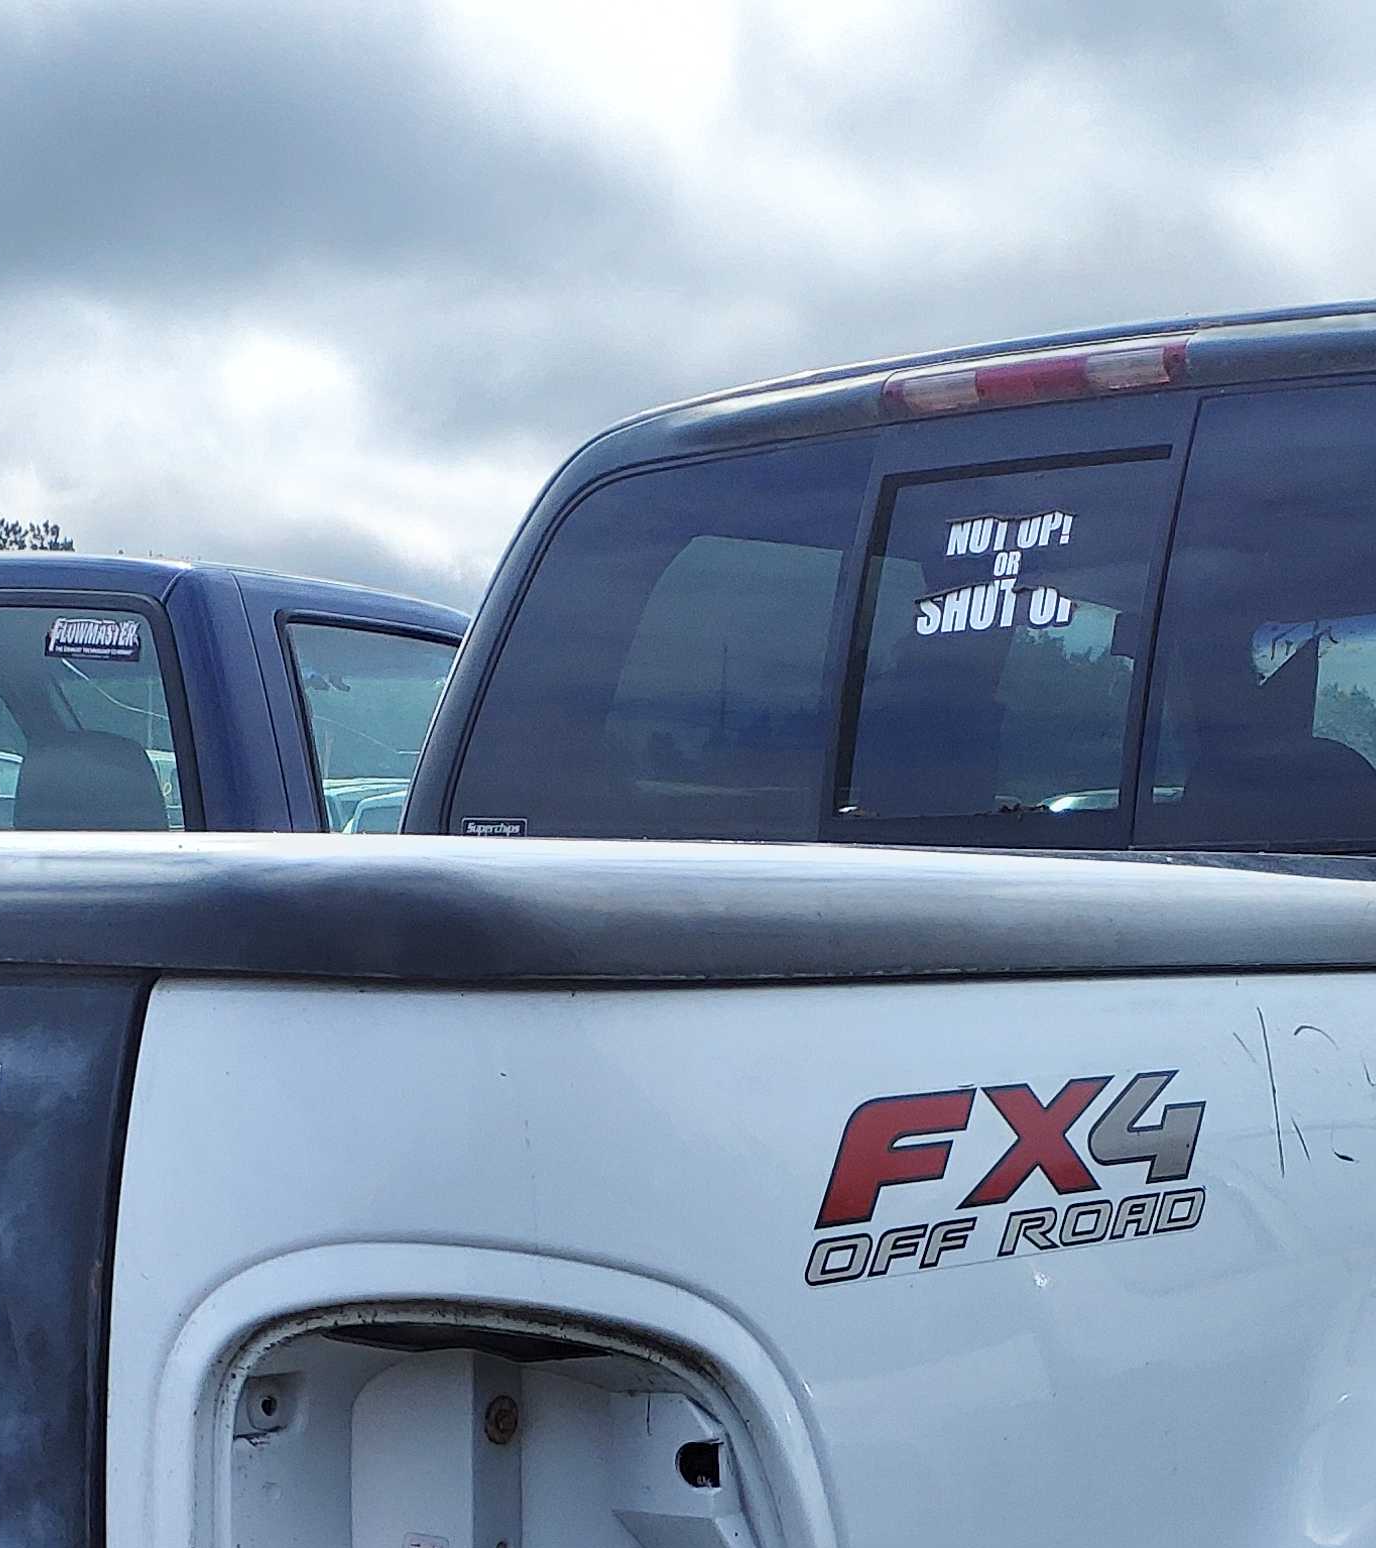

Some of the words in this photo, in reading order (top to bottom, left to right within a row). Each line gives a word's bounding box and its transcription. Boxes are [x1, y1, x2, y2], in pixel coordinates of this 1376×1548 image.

[1016, 510, 1074, 548] UP!
[993, 551, 1022, 577] OR
[916, 578, 1018, 635] SHUT
[48, 618, 141, 652] FLOWMASTER
[466, 822, 521, 836] Superchips
[814, 1069, 1207, 1230] FX4
[804, 1216, 978, 1287] OFF
[997, 1187, 1207, 1257] ROAD
